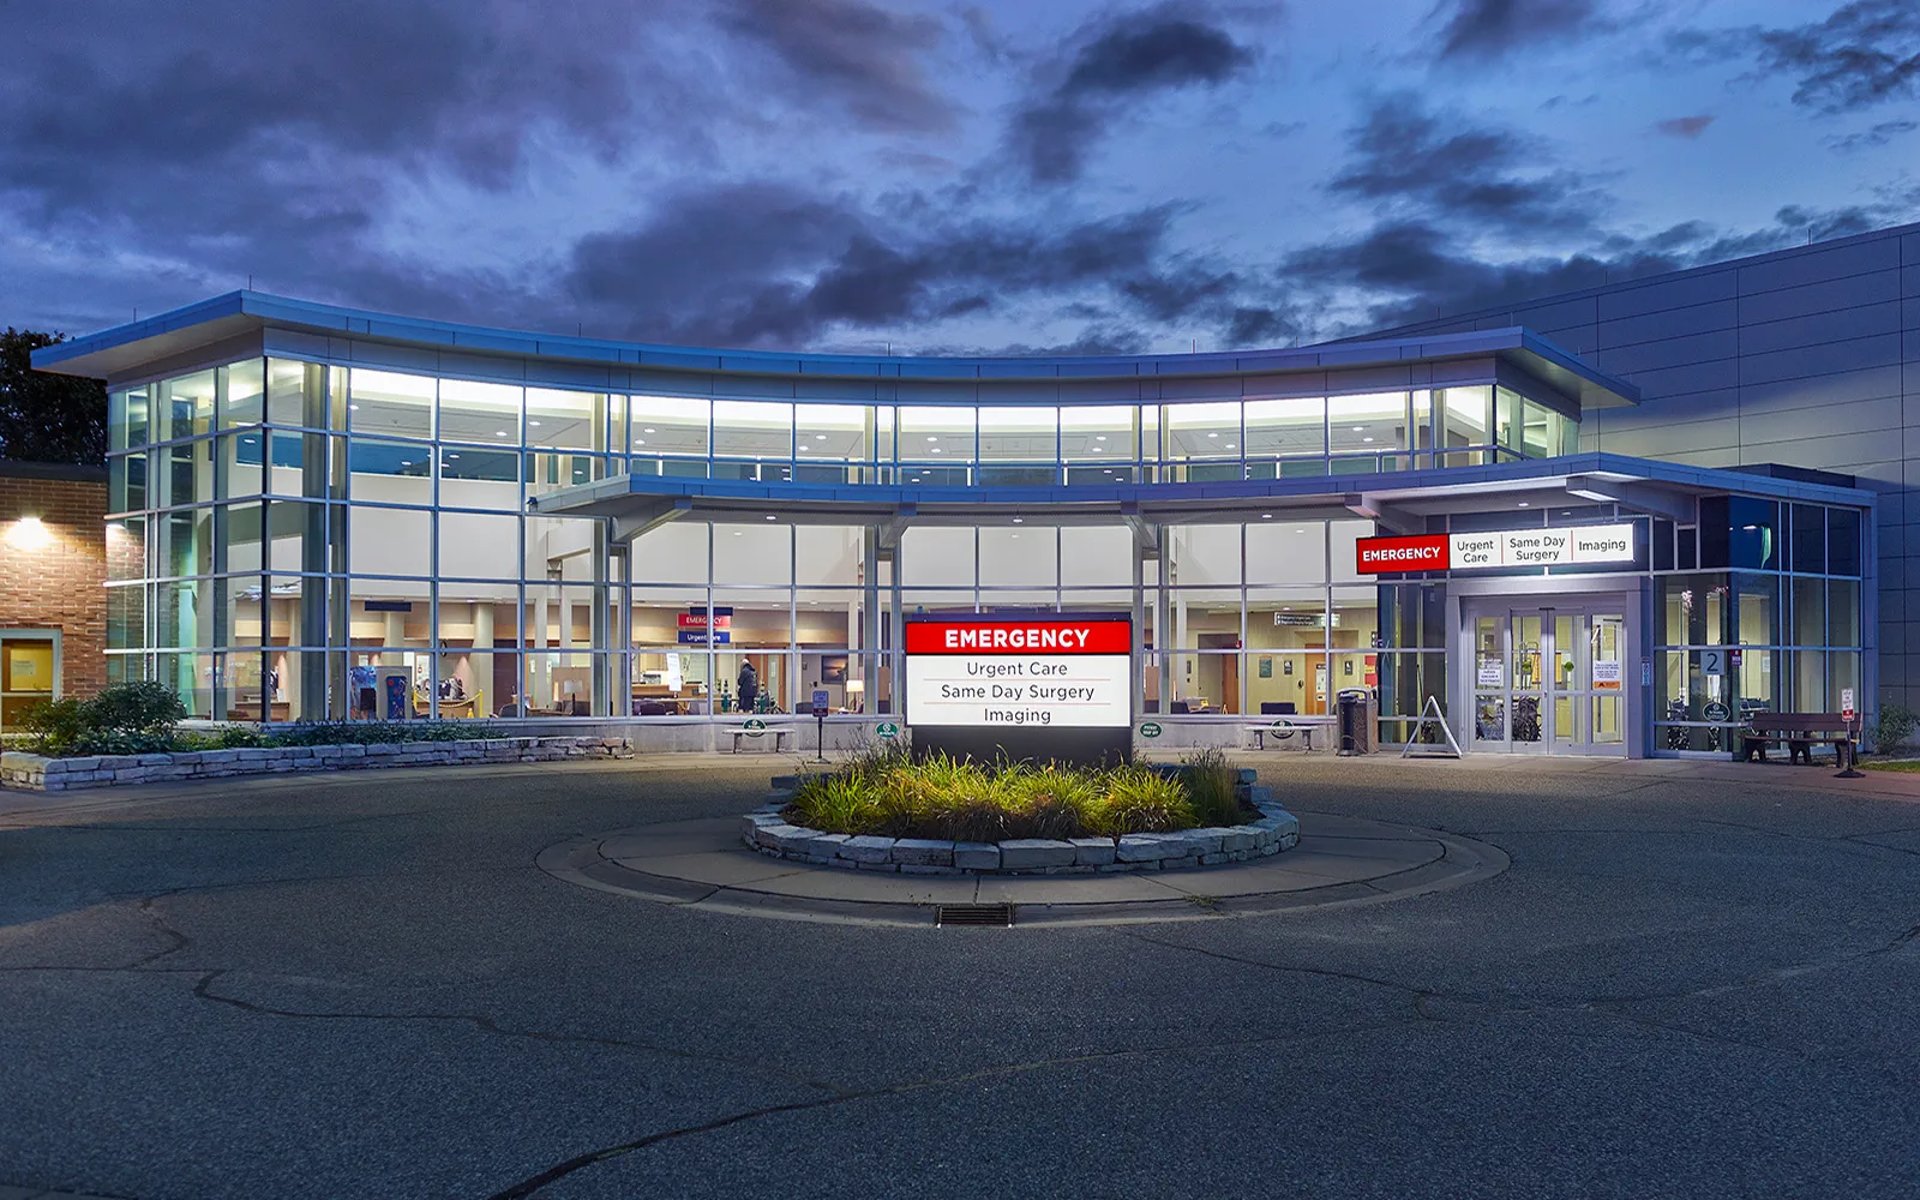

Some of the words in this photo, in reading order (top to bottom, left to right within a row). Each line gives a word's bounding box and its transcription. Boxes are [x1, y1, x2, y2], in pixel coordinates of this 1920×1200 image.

[1457, 540, 1494, 553] Urgent
[1509, 538, 1541, 549] Same
[1543, 536, 1566, 549] Day
[1578, 539, 1626, 553] Imaging
[1362, 546, 1441, 562] EMERGENCY
[1463, 552, 1489, 563] Care
[1516, 549, 1560, 563] Surgery
[686, 616, 721, 624] EMERGCY
[687, 634, 707, 642] Urgent
[945, 628, 1090, 648] EMERGENCY
[1707, 652, 1718, 672] 2
[967, 662, 1023, 678] Urgent
[1029, 661, 1068, 676] Care
[941, 684, 986, 698] Same
[992, 684, 1023, 701] Day
[1029, 684, 1095, 701] Surgery
[984, 707, 1051, 724] Imaging
